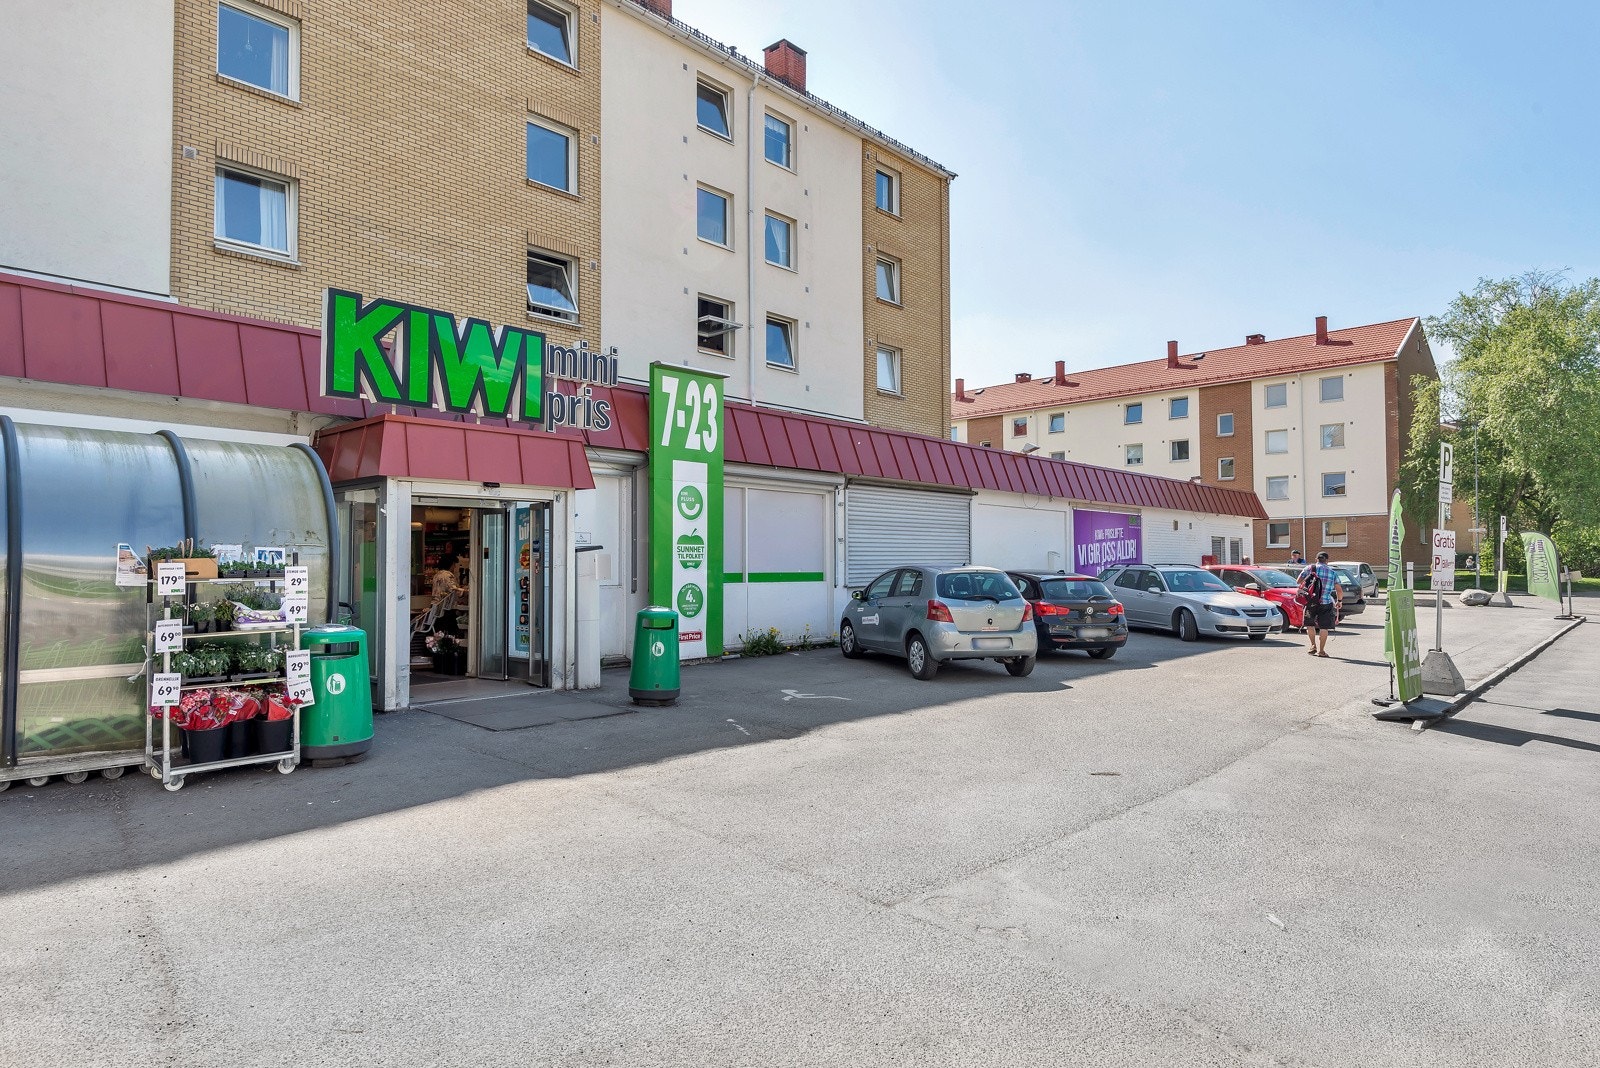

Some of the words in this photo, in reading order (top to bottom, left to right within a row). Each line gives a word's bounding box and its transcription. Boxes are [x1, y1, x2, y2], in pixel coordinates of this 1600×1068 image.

[322, 288, 546, 424] KIWI
[546, 340, 618, 387] mini
[546, 387, 612, 434] pris
[661, 375, 718, 453] 7-23
[1443, 446, 1451, 479] P
[676, 545, 705, 553] SUNNHET
[1077, 544, 1088, 566] VI
[1088, 542, 1101, 565] GIR
[1101, 540, 1116, 563] OSS
[1116, 539, 1137, 561] ALDRI
[1434, 533, 1455, 549] Gratis
[1434, 556, 1441, 570] P
